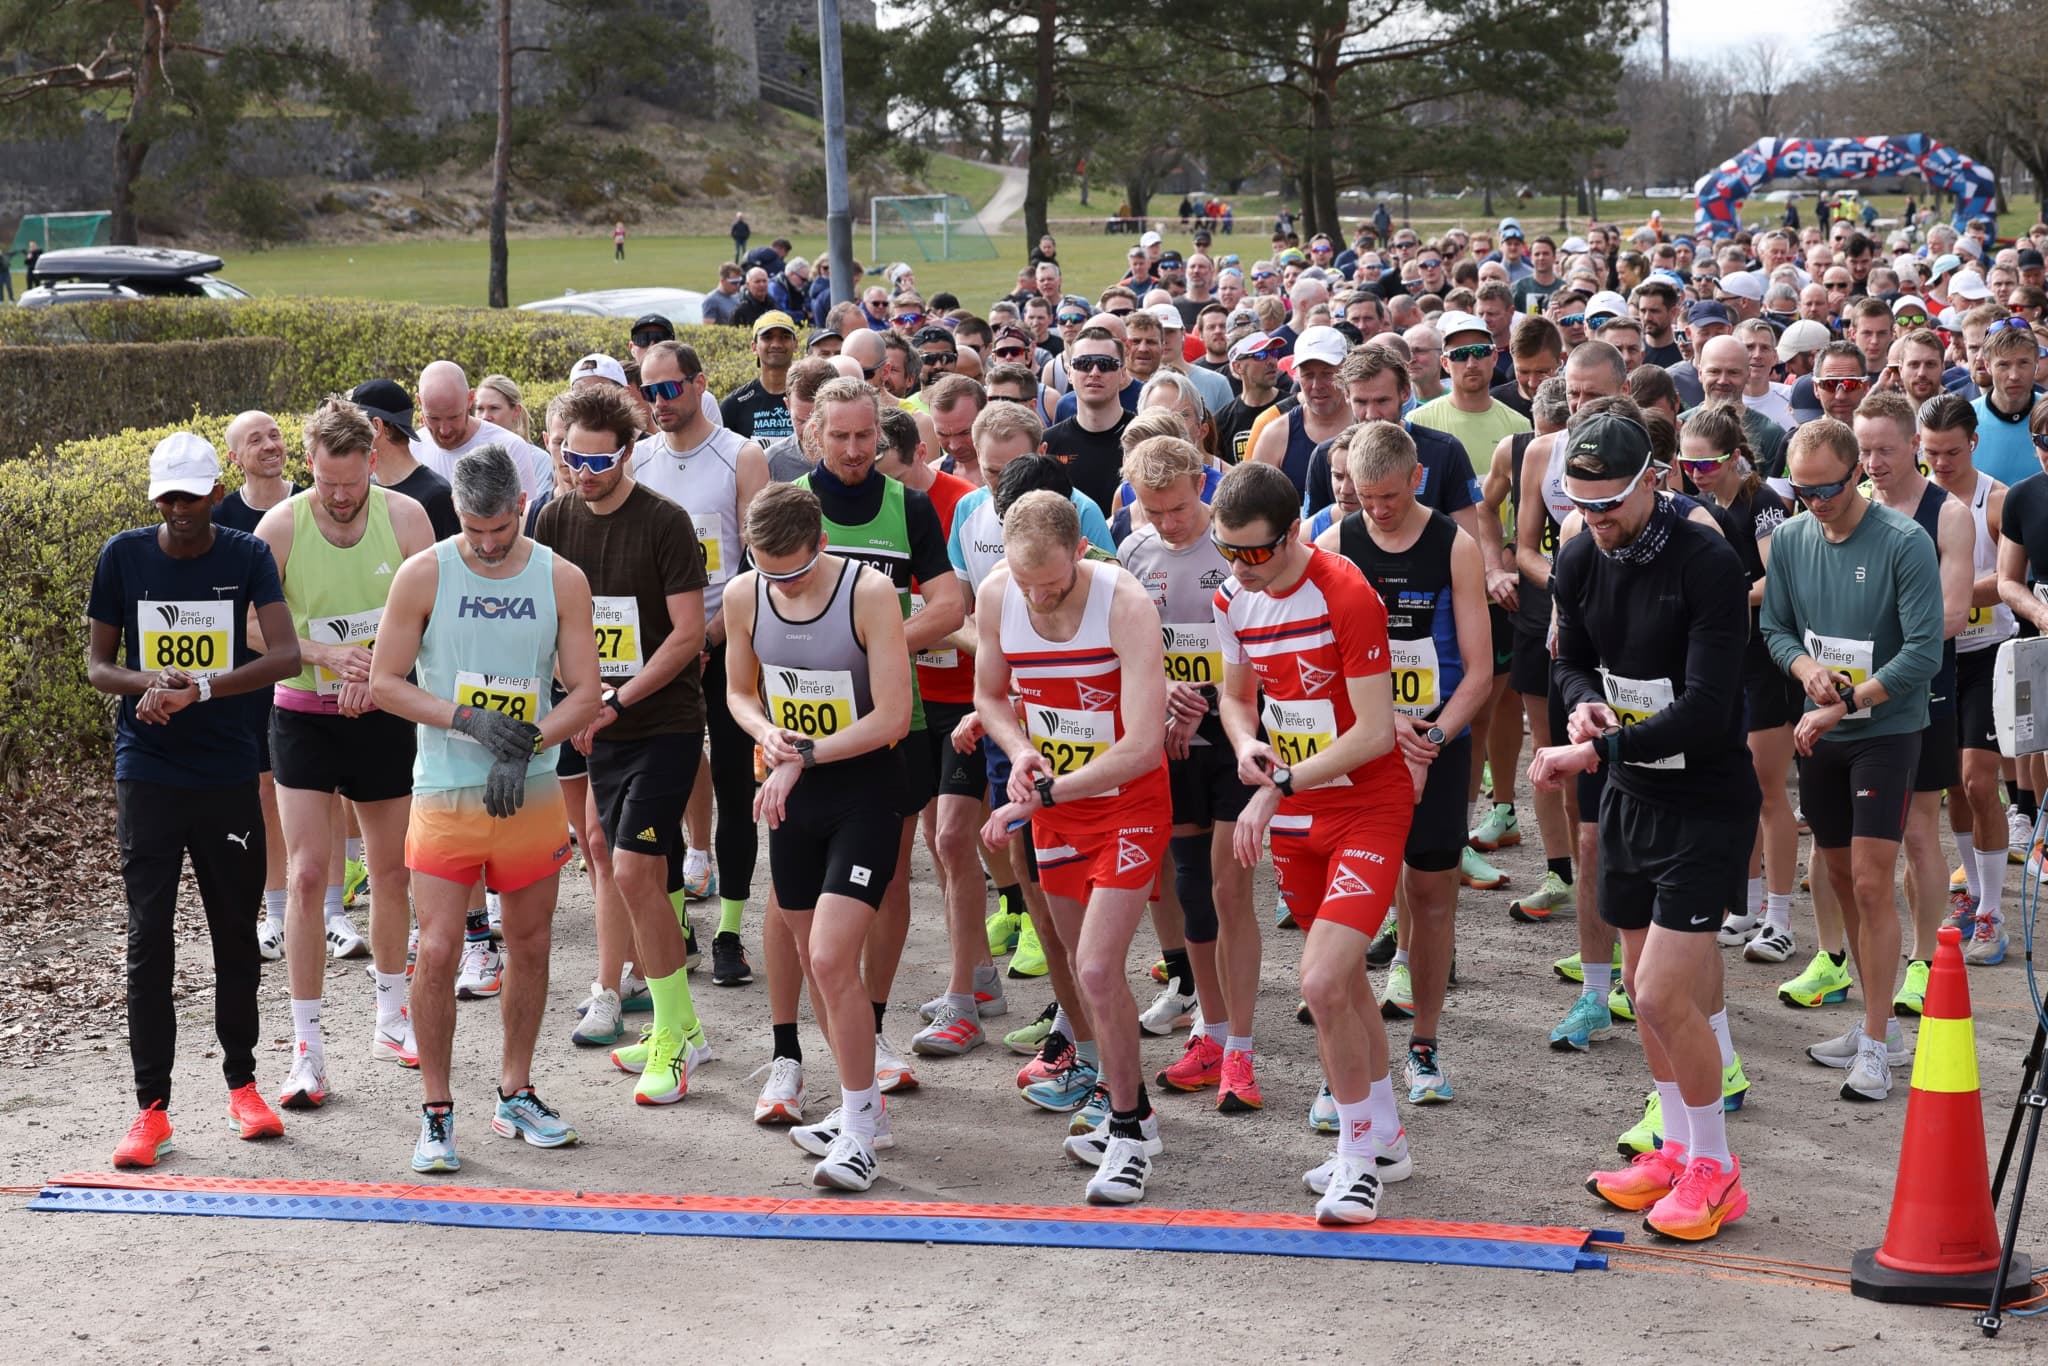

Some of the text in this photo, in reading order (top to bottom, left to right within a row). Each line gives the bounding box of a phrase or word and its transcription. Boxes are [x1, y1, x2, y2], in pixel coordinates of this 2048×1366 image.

[1784, 152, 1874, 170] CRAFT
[754, 418, 792, 429] MARATO
[458, 596, 536, 620] HOKA
[180, 616, 215, 627] energi
[596, 611, 622, 622] energi
[351, 620, 367, 629] Smart
[351, 623, 379, 636] energ
[594, 628, 622, 658] 27
[1177, 638, 1209, 649] energi
[157, 635, 214, 667] 880
[1823, 651, 1855, 664] energi
[621, 665, 629, 673] IF
[499, 675, 530, 689] energi
[1391, 671, 1419, 702] 40
[800, 685, 834, 696] energi
[1620, 687, 1637, 695] Smart
[471, 691, 526, 720] 878
[1620, 694, 1653, 708] energi
[783, 701, 837, 735] 860
[1416, 708, 1424, 716] IF
[1061, 718, 1078, 726] Smart
[1285, 717, 1315, 729] energi
[1060, 725, 1094, 738] energi
[1277, 734, 1318, 767] 614
[1041, 741, 1095, 775] 627
[1342, 849, 1385, 864] TRIMTEX
